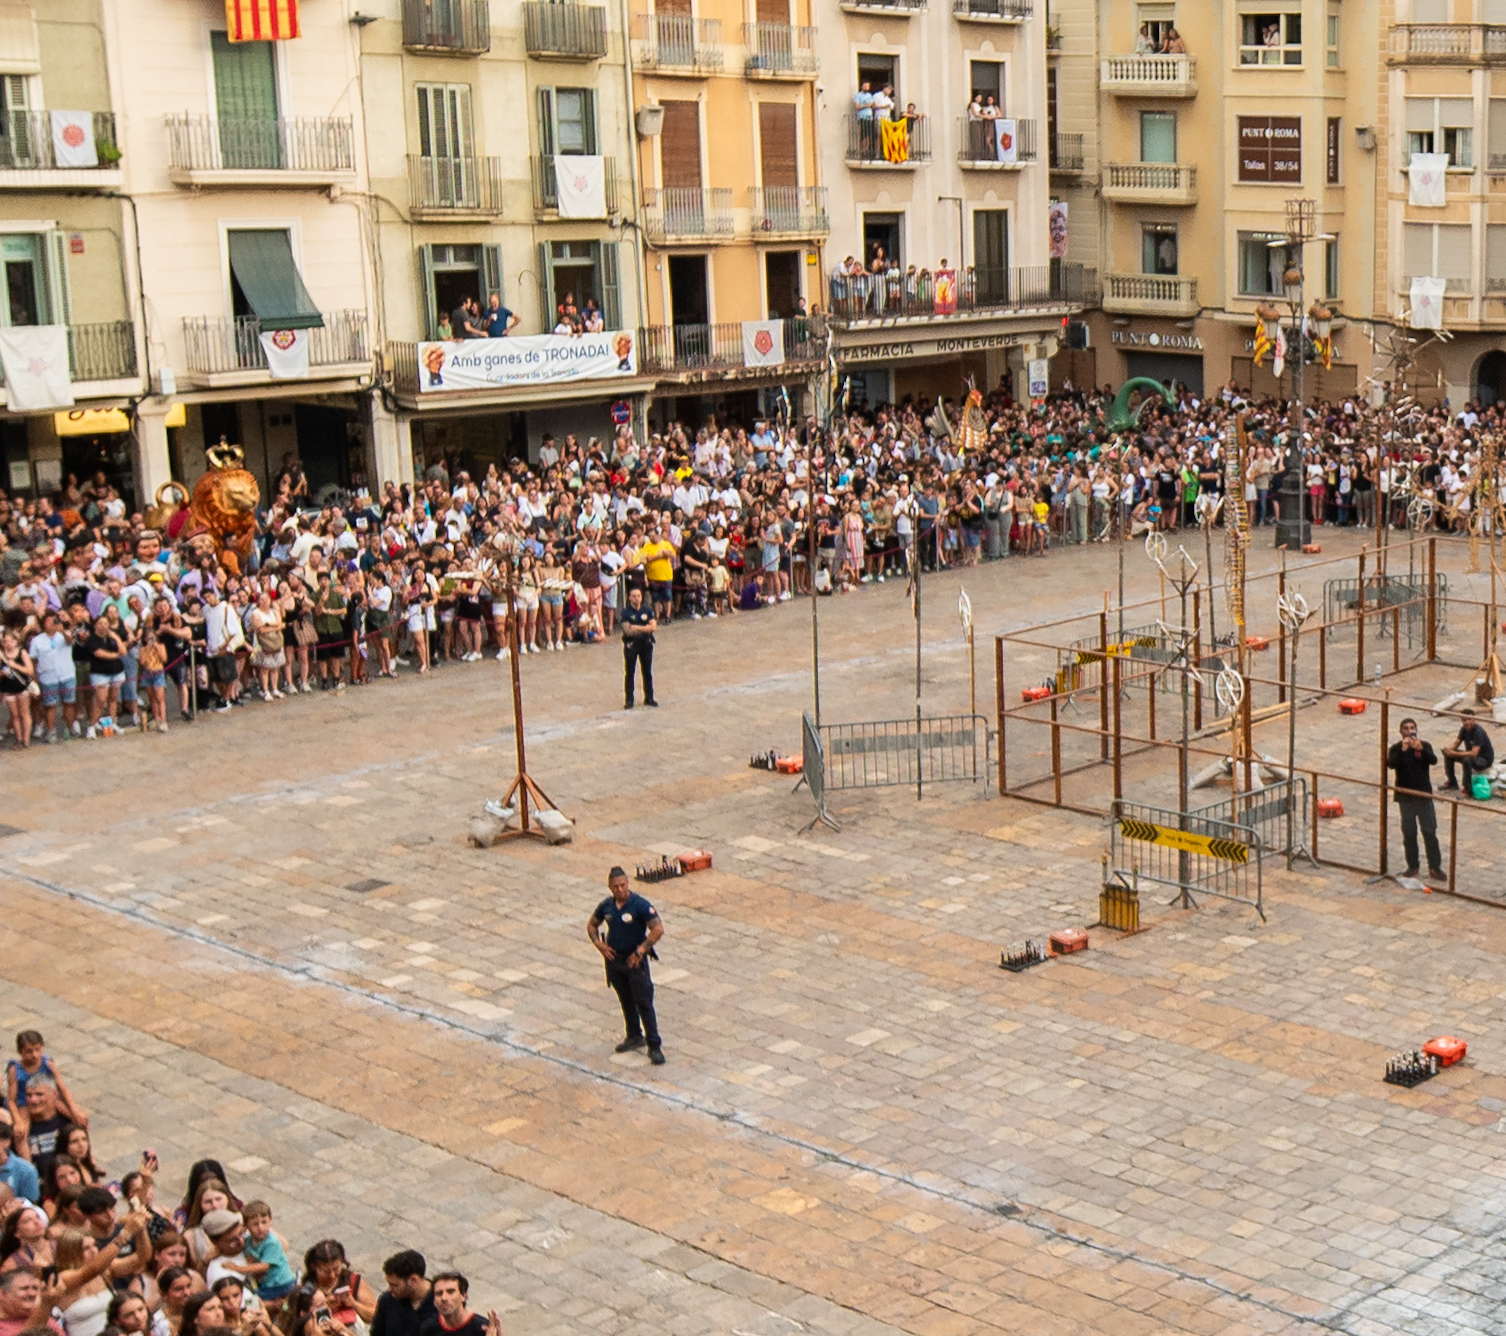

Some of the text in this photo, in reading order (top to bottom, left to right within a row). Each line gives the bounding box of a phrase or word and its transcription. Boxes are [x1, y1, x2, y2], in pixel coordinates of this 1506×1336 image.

[1242, 128, 1299, 138] PUNT ROMA
[1243, 160, 1298, 170] Tallas 38/54
[843, 334, 1018, 360] FARMACIA MONTEVERDE
[1111, 330, 1203, 349] PUNT ROMA
[451, 344, 609, 370] Amb ganes de TRONADA!
